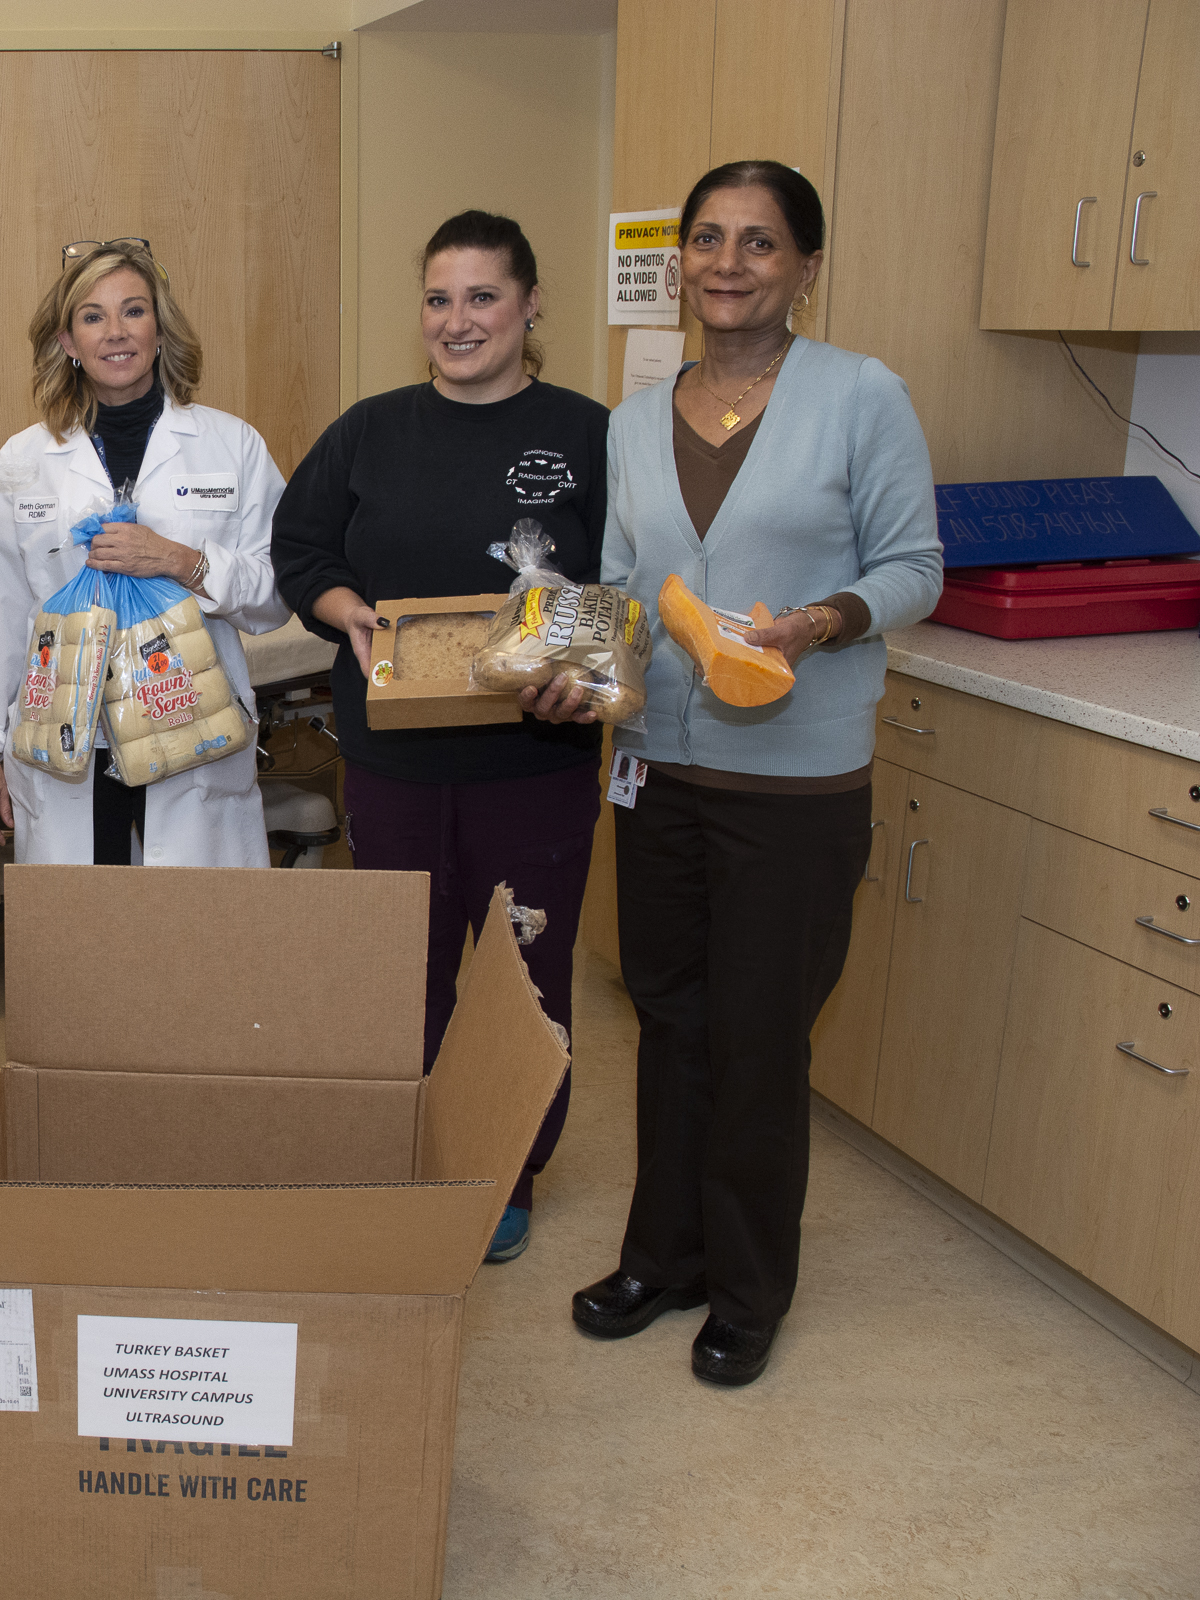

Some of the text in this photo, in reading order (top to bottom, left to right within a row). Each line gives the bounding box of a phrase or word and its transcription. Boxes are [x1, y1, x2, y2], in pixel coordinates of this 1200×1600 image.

[619, 224, 680, 239] PRIVACY NOTI
[618, 253, 665, 268] NO PHOTOS
[617, 271, 657, 285] OR VIDEO
[616, 289, 657, 302] ALLOWED
[523, 449, 564, 459] DIAGNOSTIC
[551, 462, 567, 470] MRI
[518, 472, 563, 480] RADIOLOGY
[558, 481, 577, 489] CVIT
[517, 497, 555, 505] IMAGING
[965, 484, 1040, 511] FOUND
[1042, 480, 1123, 506] PLEASE
[34, 502, 56, 510] Gorman
[28, 510, 46, 519] RDMS
[545, 583, 586, 648] RUSSE
[579, 590, 600, 630] BAKIG
[592, 586, 614, 645] POTAT
[151, 690, 199, 719] Serve
[168, 712, 194, 727] Rolls
[115, 1343, 230, 1359] TURKEY BASKET
[103, 1366, 229, 1383] UMASS HOSPITAL
[103, 1387, 254, 1404] UNIVERSITY CAMPUS
[125, 1411, 225, 1426] ULTRASOUND
[78, 1470, 308, 1503] HANDLE WITH CARE
